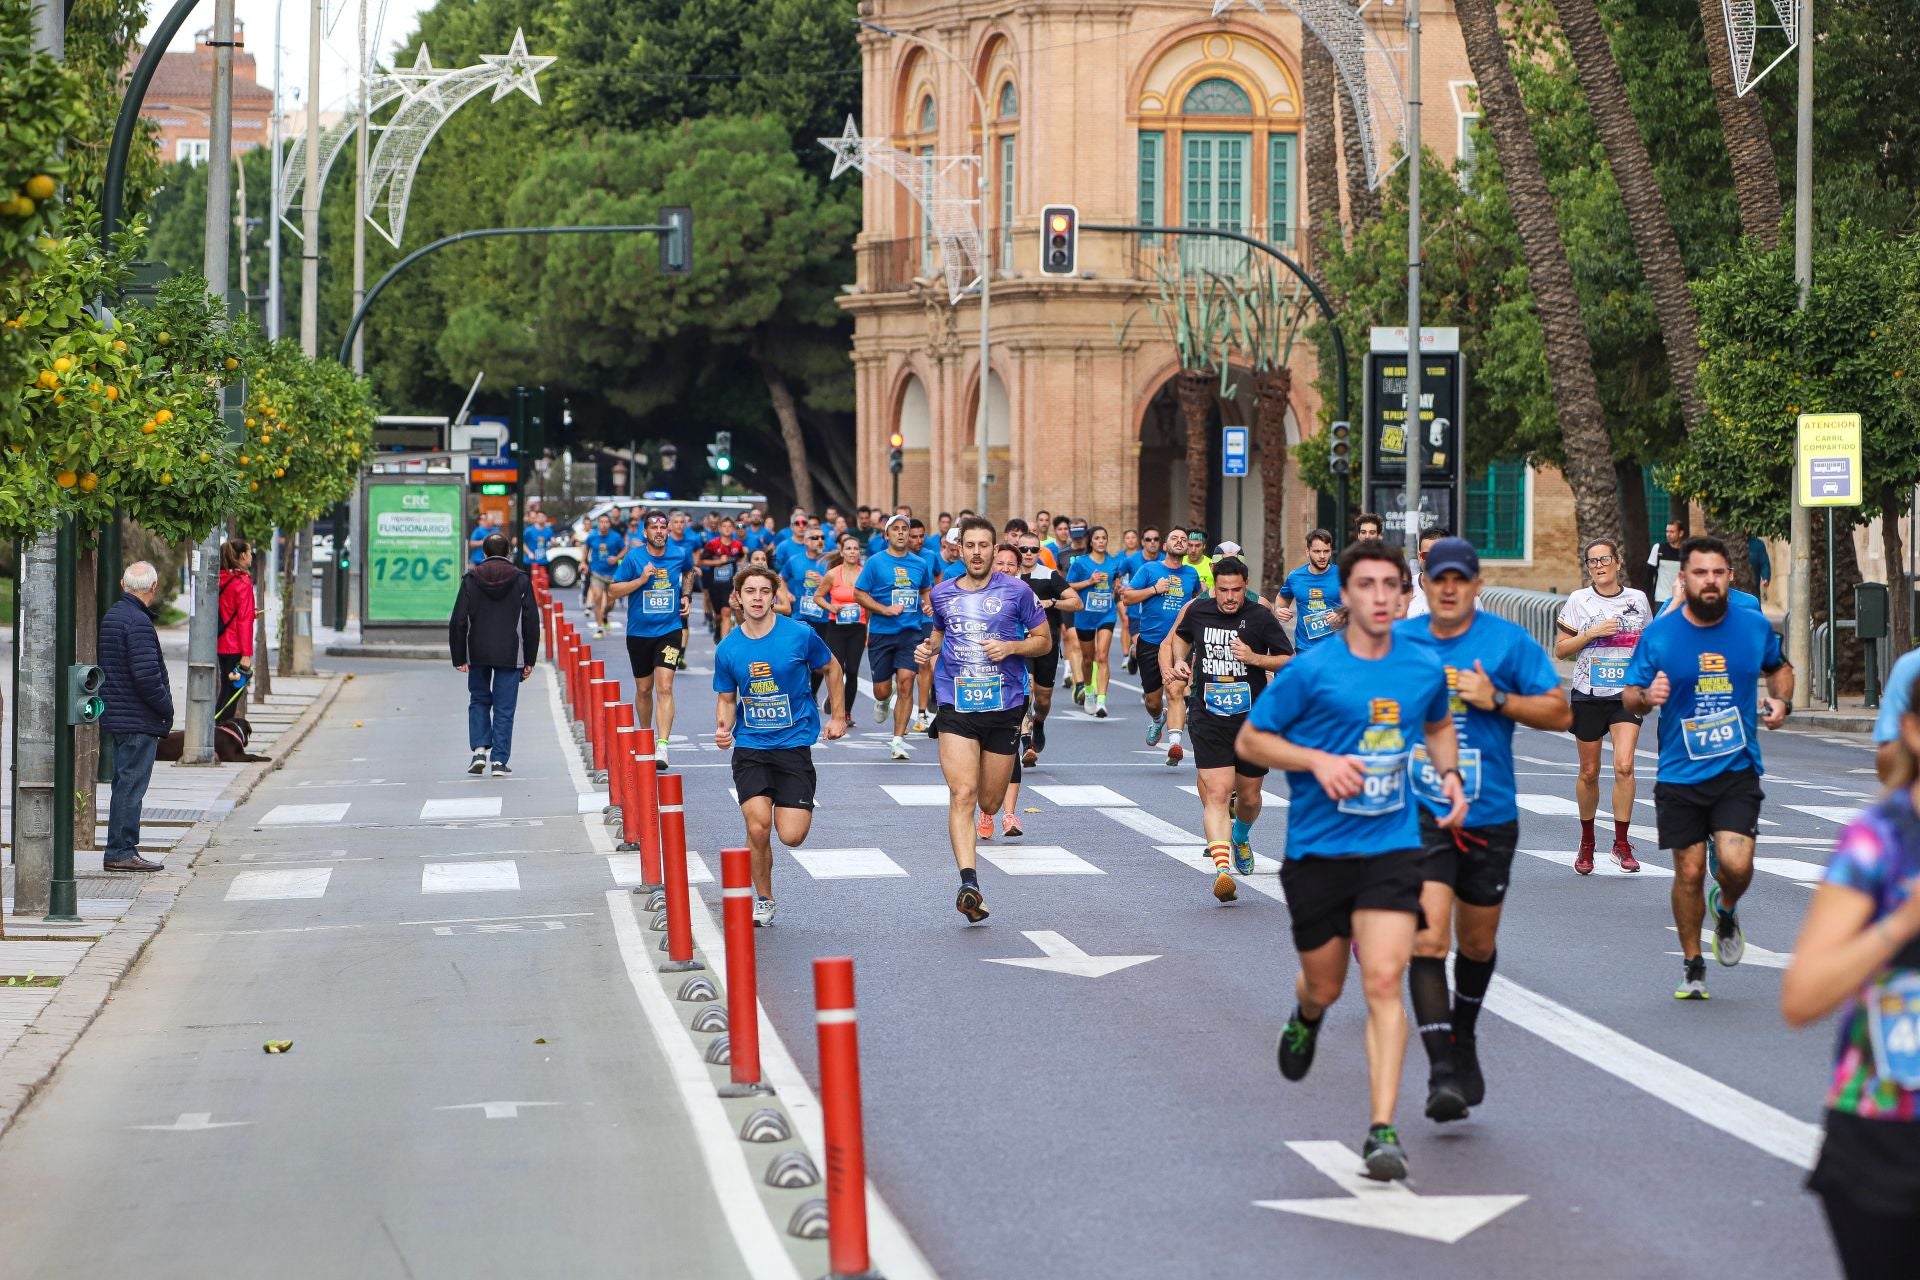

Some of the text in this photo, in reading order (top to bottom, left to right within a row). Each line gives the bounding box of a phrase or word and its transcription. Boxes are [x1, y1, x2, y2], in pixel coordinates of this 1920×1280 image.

[1804, 443, 1856, 451] COMPARTIDO
[402, 494, 430, 506] CRC
[380, 523, 450, 533] FUNCIONARIOS
[374, 557, 454, 581] 120€
[650, 597, 670, 606] 682
[898, 597, 915, 606] 570
[964, 622, 988, 631] Ges
[1203, 627, 1238, 645] UNITS
[1202, 658, 1248, 677] SEMPRE
[1598, 667, 1625, 679] 389
[963, 688, 993, 702] 394
[1213, 693, 1243, 706] 343
[748, 706, 787, 719] 1003
[1695, 725, 1735, 746] 749
